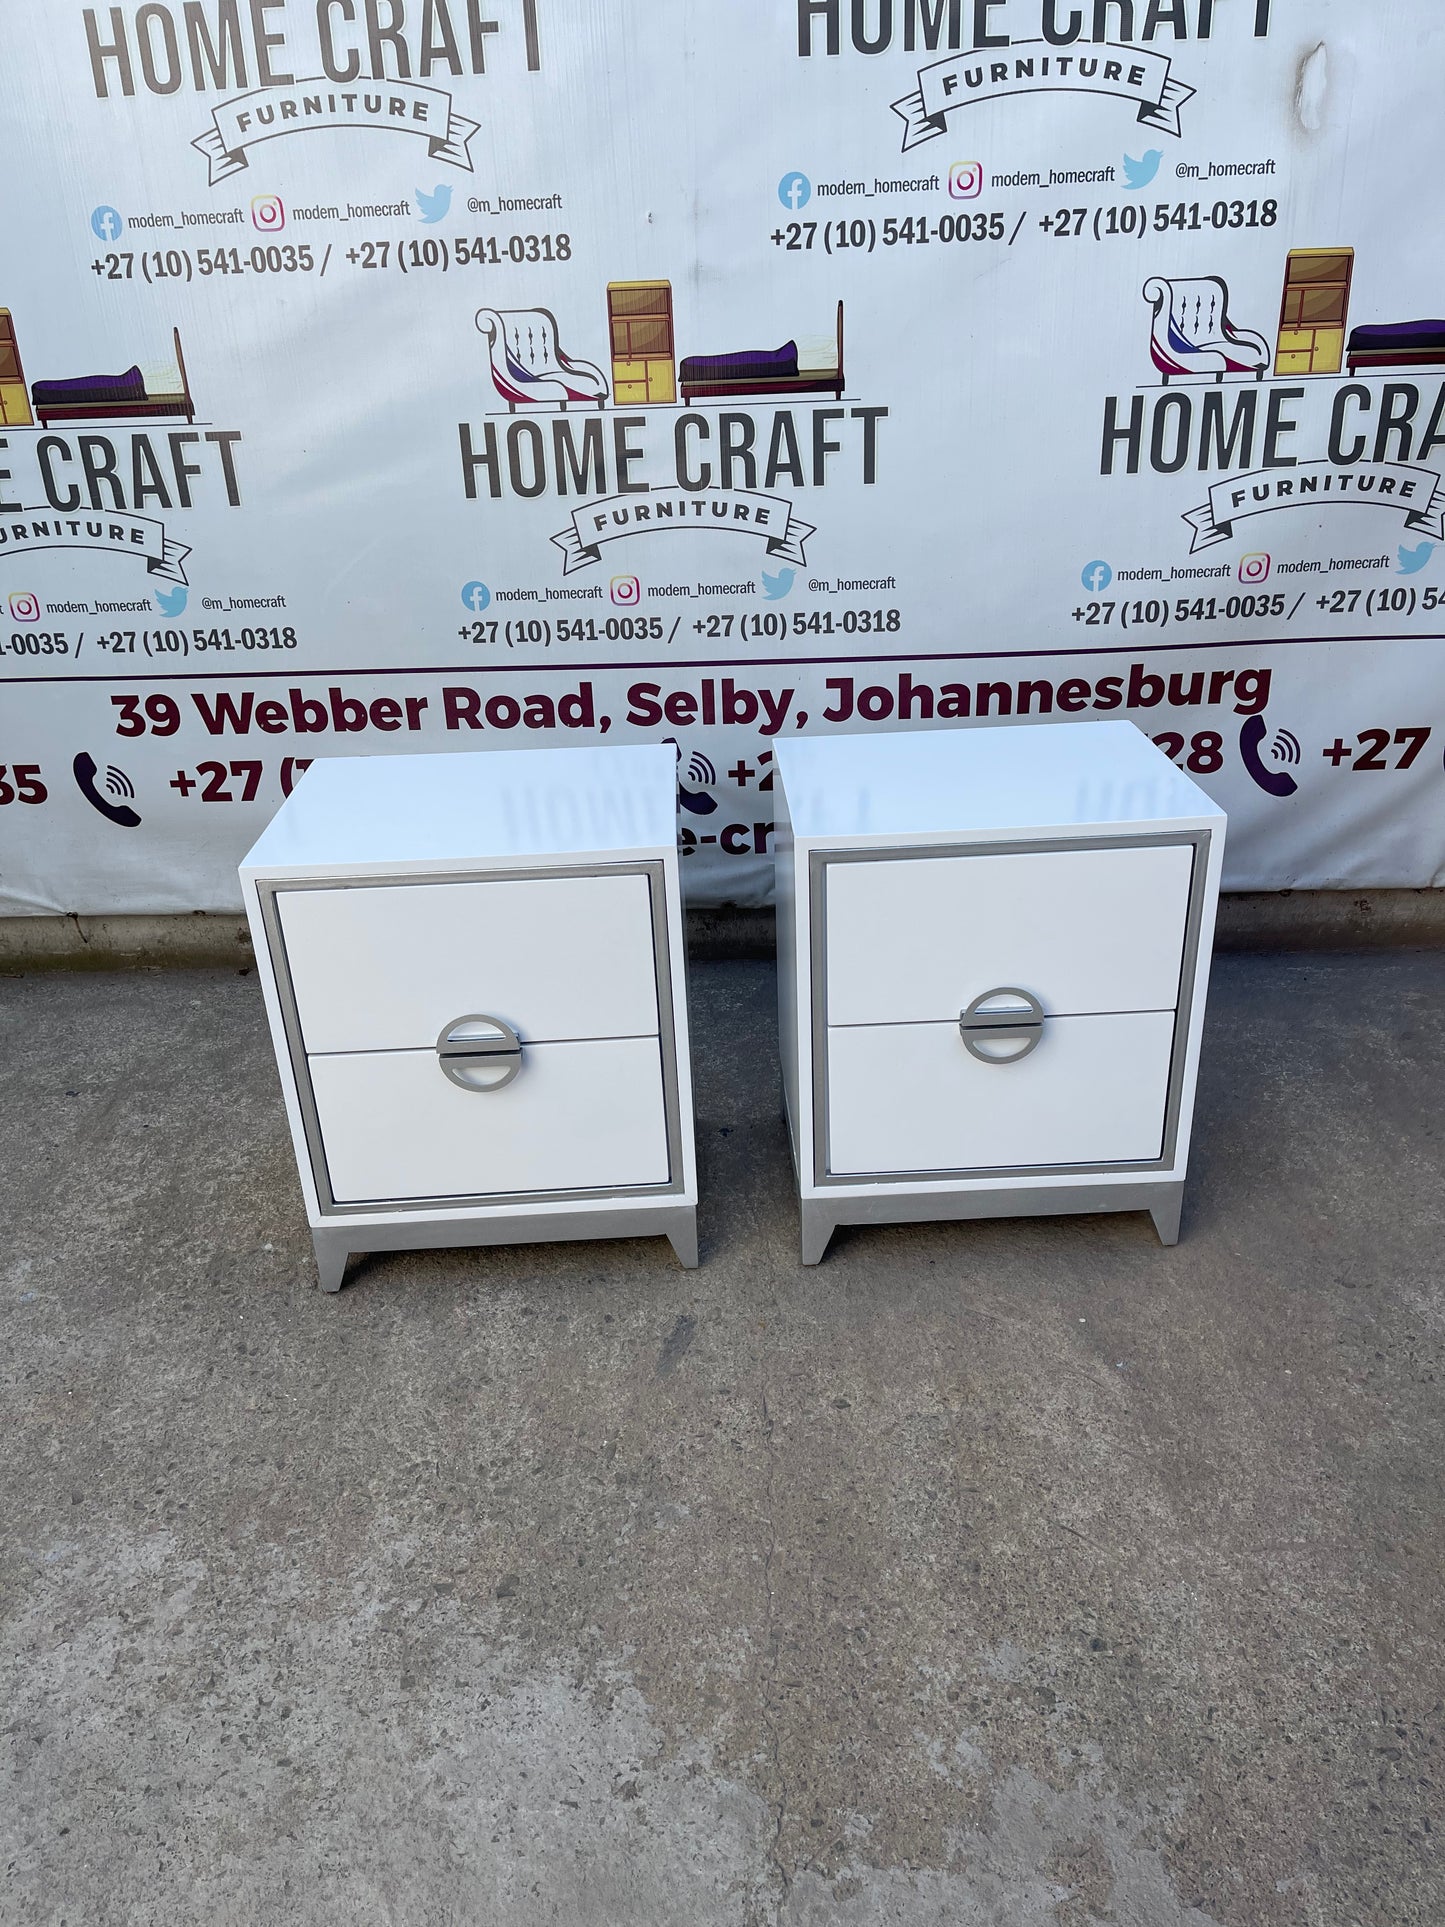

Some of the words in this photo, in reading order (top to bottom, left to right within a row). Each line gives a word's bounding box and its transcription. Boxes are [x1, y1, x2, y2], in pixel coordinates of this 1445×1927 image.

[82, 0, 295, 98] HOME
[943, 57, 1145, 96] FURNITURE
[236, 94, 428, 133] FURNITURE
[1176, 159, 1275, 180] @m_homecraft
[468, 194, 562, 215] @m_homecraft
[771, 222, 817, 250] +27
[824, 219, 875, 254] (10)
[883, 213, 1004, 245] 541-0035
[1039, 208, 1087, 236] +27
[1094, 206, 1146, 241] (10)
[1153, 199, 1277, 231] 541-0318
[91, 253, 134, 279] +27
[142, 250, 192, 284] (10)
[197, 245, 314, 275] 541-0035
[346, 241, 390, 268] +27
[398, 239, 448, 273] (10)
[455, 234, 571, 265] 541-0318
[1100, 387, 1304, 475] HOME
[37, 430, 242, 512] CRAFT
[458, 417, 650, 499] HOME
[674, 407, 889, 492] CRAFT
[1231, 474, 1417, 507] FURNITURE
[594, 500, 771, 531] FURNITURE
[202, 595, 286, 611] @m_homecraft
[809, 576, 896, 593] @m_homecraft
[1072, 602, 1115, 625] +27
[1121, 600, 1169, 628] (10)
[1175, 594, 1285, 621] 541-0035
[1316, 590, 1362, 613] +27
[1366, 588, 1416, 616] (10)
[97, 631, 136, 653] +27
[143, 630, 188, 657] (10)
[193, 627, 297, 651] 541-0318
[458, 622, 498, 643] +27
[505, 620, 551, 647] (10)
[557, 617, 663, 641] 541-0035
[693, 615, 734, 637] +27
[741, 613, 787, 641] (10)
[793, 609, 900, 635] 541-0318
[110, 694, 181, 737] 39
[191, 688, 428, 735] Webber
[443, 682, 611, 733] Road,
[627, 676, 808, 731] Selby,
[823, 664, 1272, 722] Johannesburg
[1323, 727, 1431, 770] +27
[170, 760, 263, 802] +27
